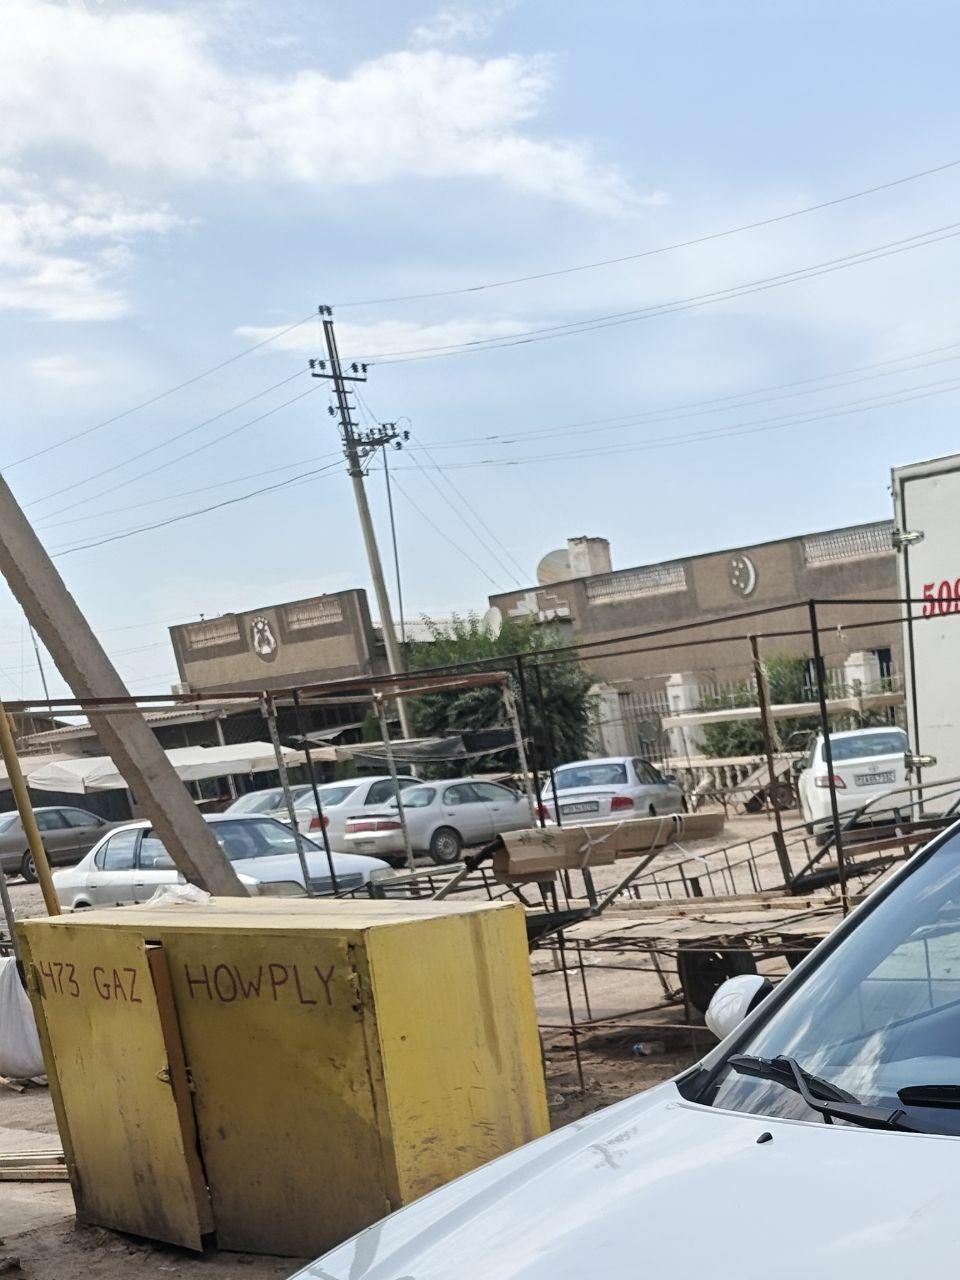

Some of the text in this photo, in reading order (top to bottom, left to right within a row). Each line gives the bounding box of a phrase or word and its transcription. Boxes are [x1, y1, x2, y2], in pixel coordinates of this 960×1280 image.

[40, 961, 335, 1006] 473 GAZ HOWPLY
